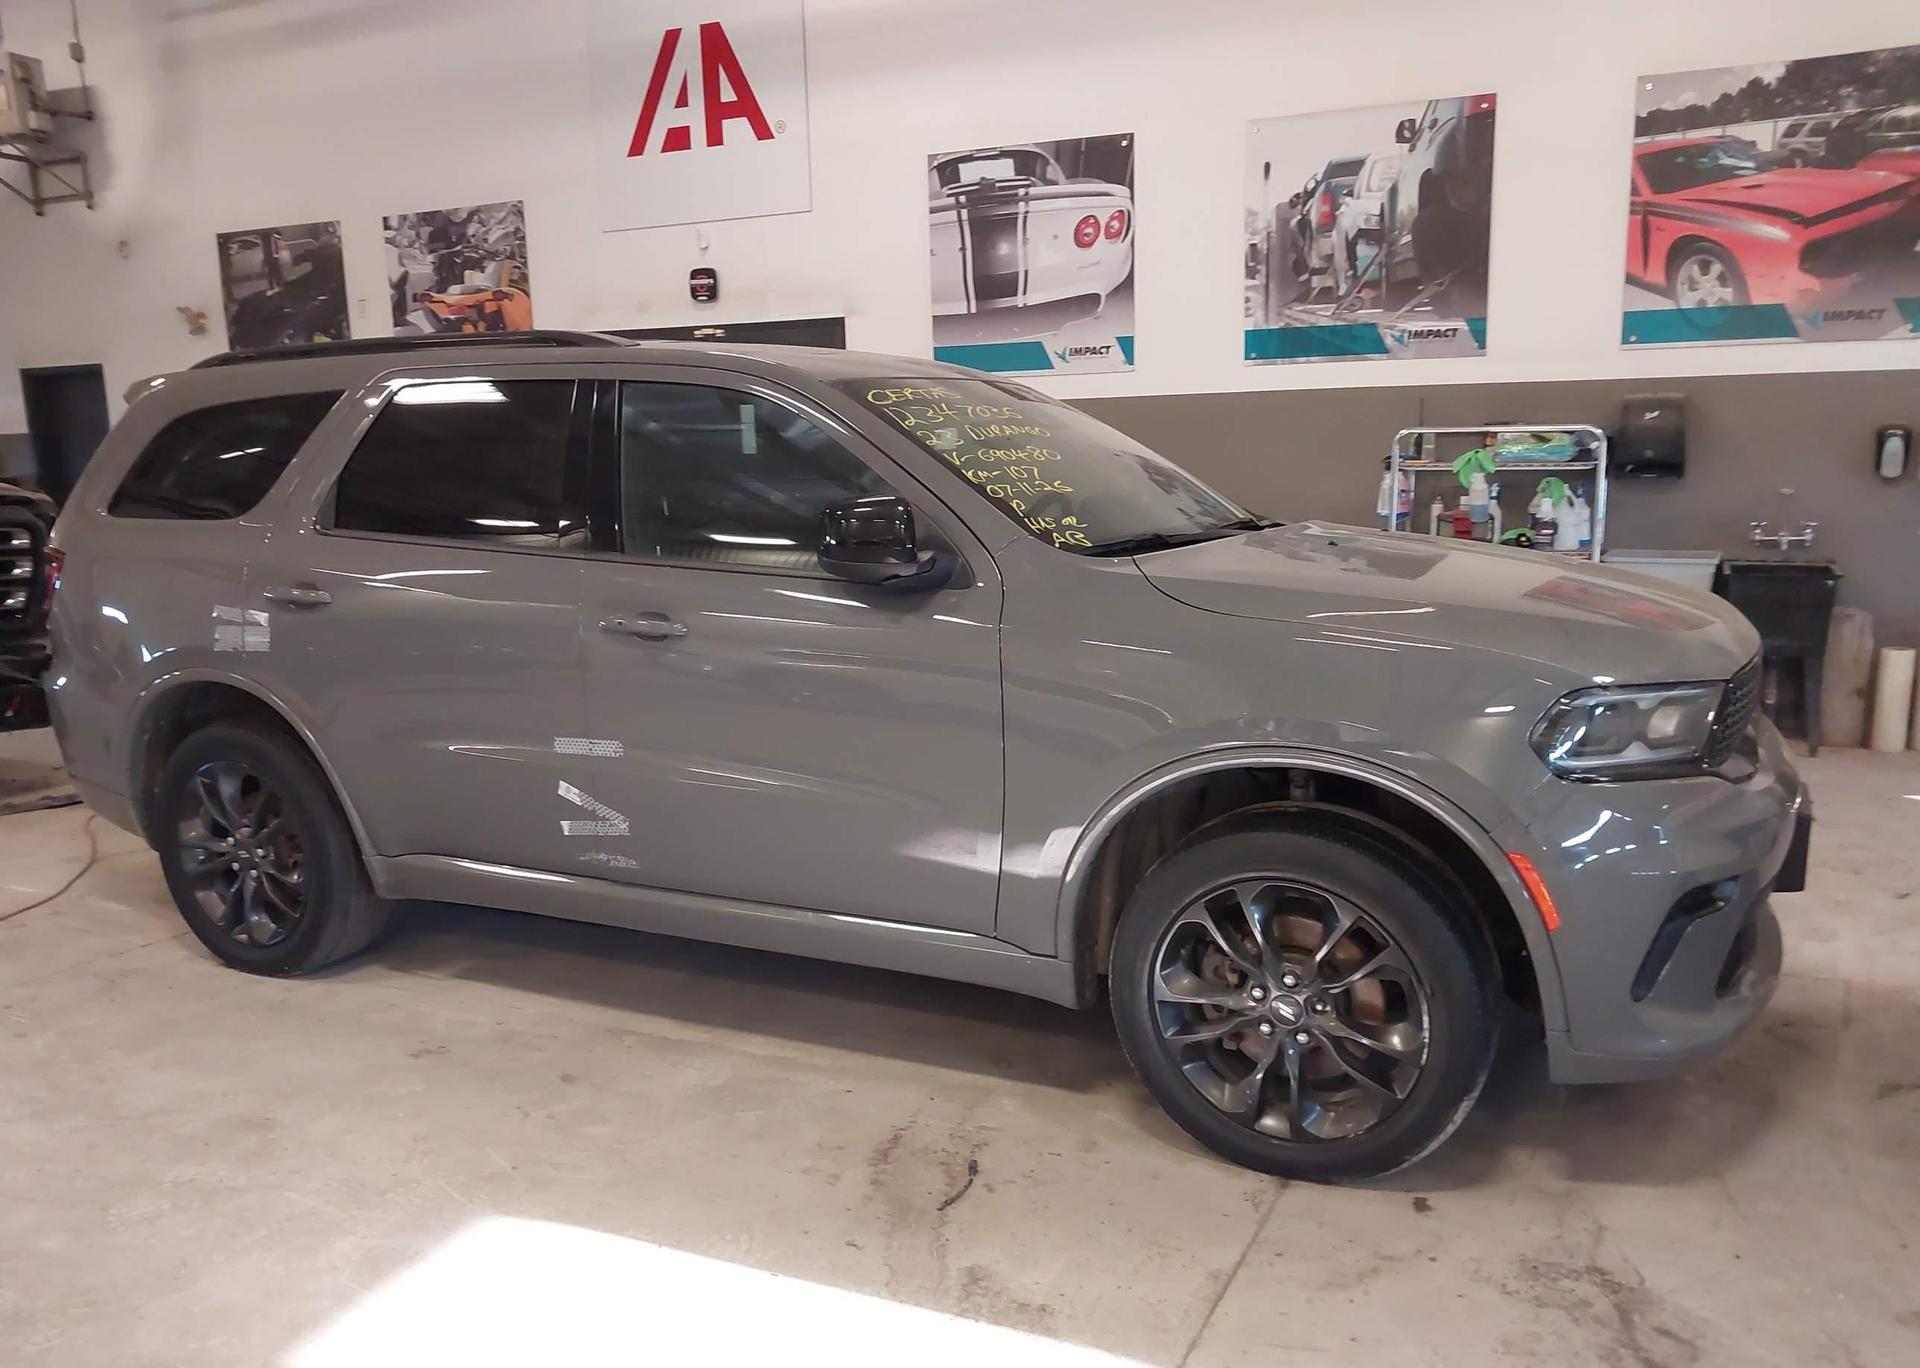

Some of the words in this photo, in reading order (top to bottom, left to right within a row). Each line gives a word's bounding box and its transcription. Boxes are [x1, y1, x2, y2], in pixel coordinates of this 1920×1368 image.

[1823, 308, 1887, 322] IMPACT
[1407, 328, 1460, 340] IMPACT
[1068, 345, 1113, 357] IMPACT
